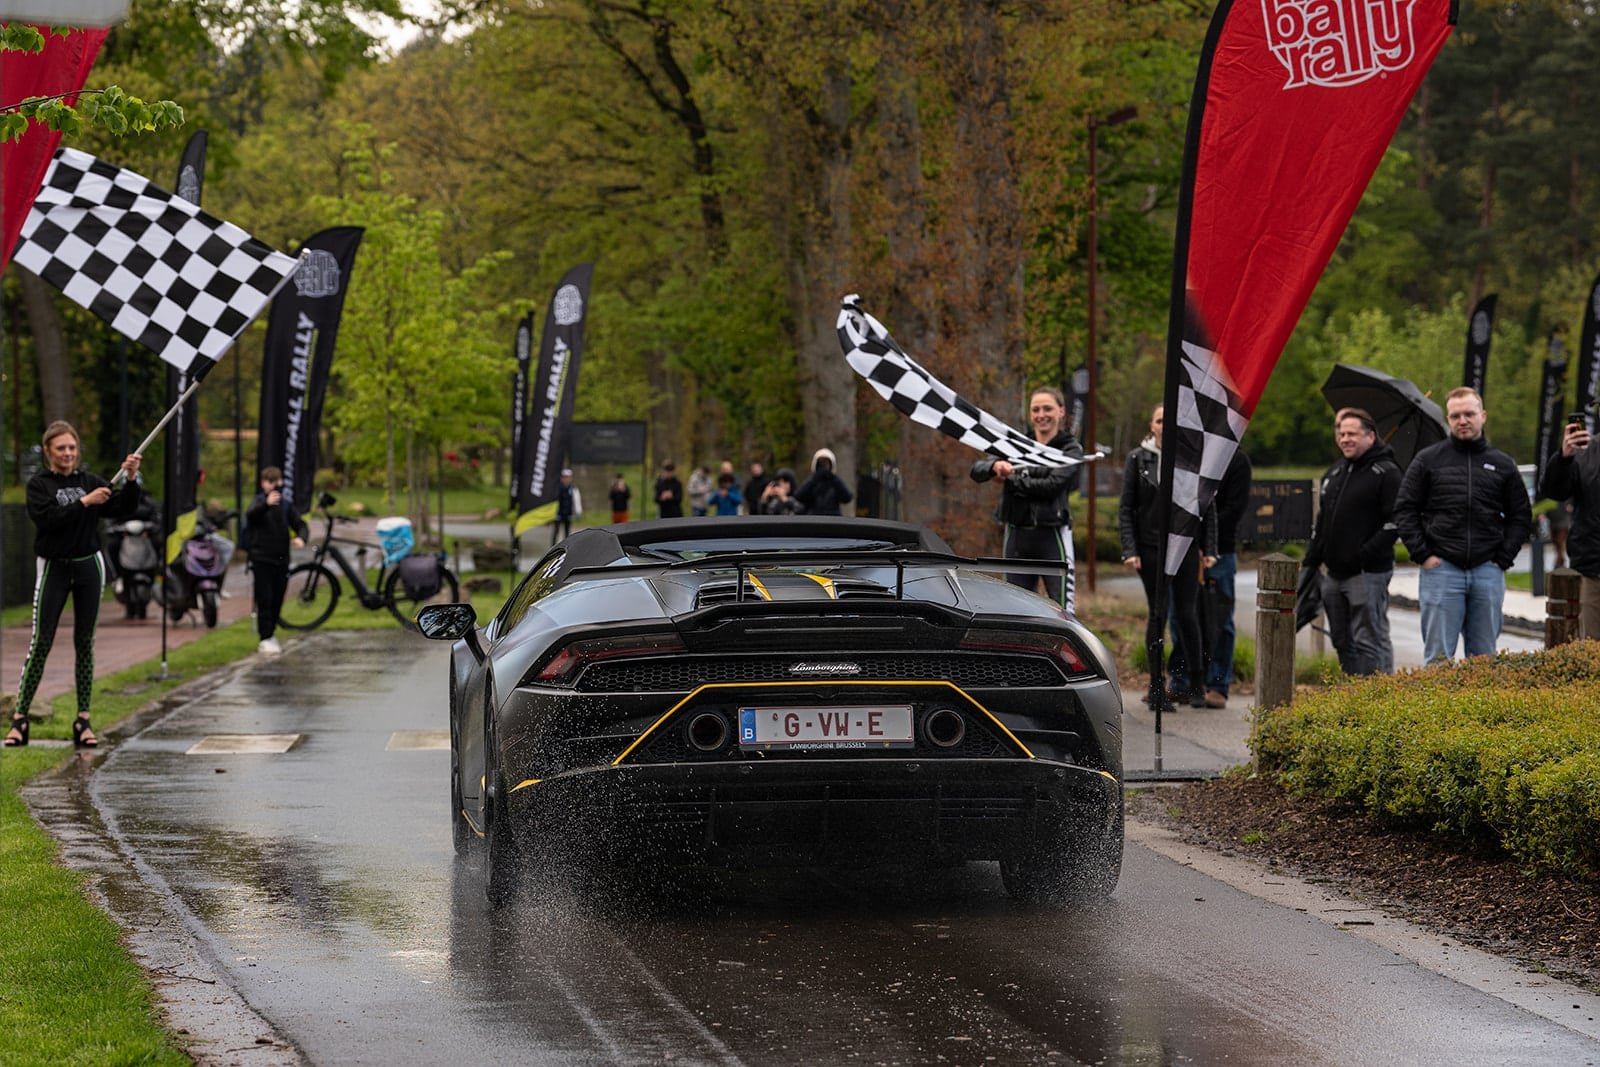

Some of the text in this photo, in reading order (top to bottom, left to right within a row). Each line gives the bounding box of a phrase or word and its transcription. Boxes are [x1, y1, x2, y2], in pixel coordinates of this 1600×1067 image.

[289, 311, 315, 391] RALLY
[530, 405, 555, 497] RUNBALL
[546, 336, 568, 402] RALLY
[789, 662, 858, 673] Lamborghini
[784, 711, 884, 737] G-VW-E
[744, 728, 753, 739] B
[789, 740, 867, 750] LAMBORGHINI BRUSSELS
